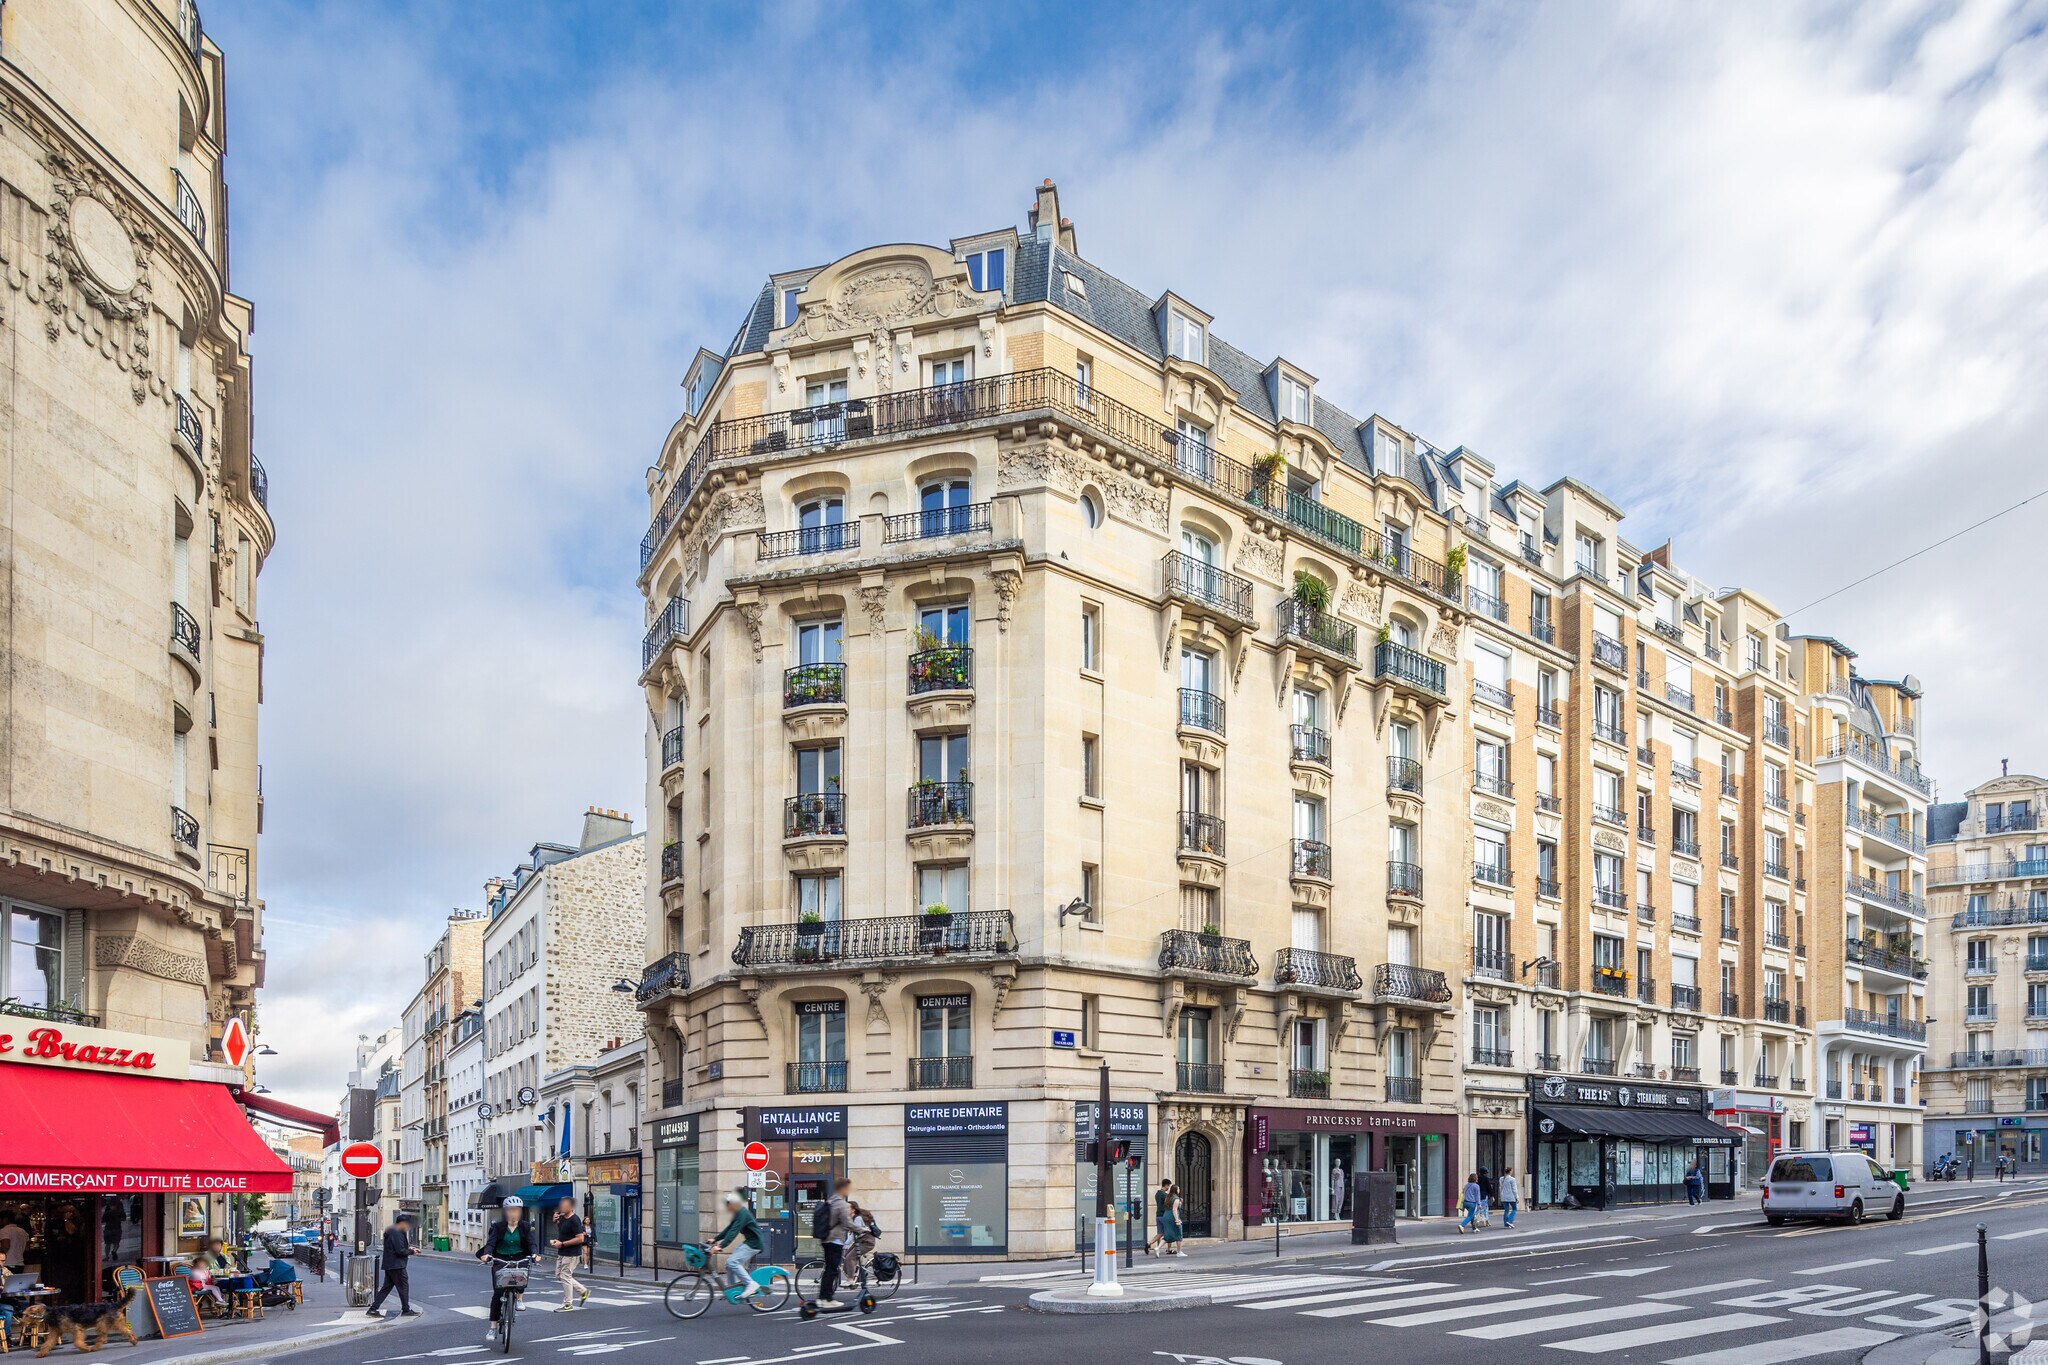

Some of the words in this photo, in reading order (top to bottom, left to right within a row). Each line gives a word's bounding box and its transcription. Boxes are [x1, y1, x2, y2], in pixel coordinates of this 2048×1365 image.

[804, 1002, 840, 1012] CENTRE
[922, 996, 968, 1007] DENTAIRE
[23, 1027, 156, 1069] Brazza
[1578, 1088, 1597, 1100] THE
[1637, 1092, 1667, 1104] STEAKHOUSE
[910, 1108, 950, 1119] CENTRE
[952, 1106, 1003, 1117] DENTAIRE
[1120, 1108, 1132, 1119] 58
[1133, 1108, 1144, 1120] 58
[1306, 1115, 1363, 1126] PRINCESSE
[775, 1126, 819, 1136] Vaugirard
[907, 1124, 936, 1133] Chirurgie
[967, 1123, 1006, 1131] Orthodontie
[476, 1128, 484, 1166] COIFFURE
[800, 1152, 822, 1163] 290
[196, 1176, 247, 1189] LOCALE
[1711, 1284, 2006, 1328] BUS
